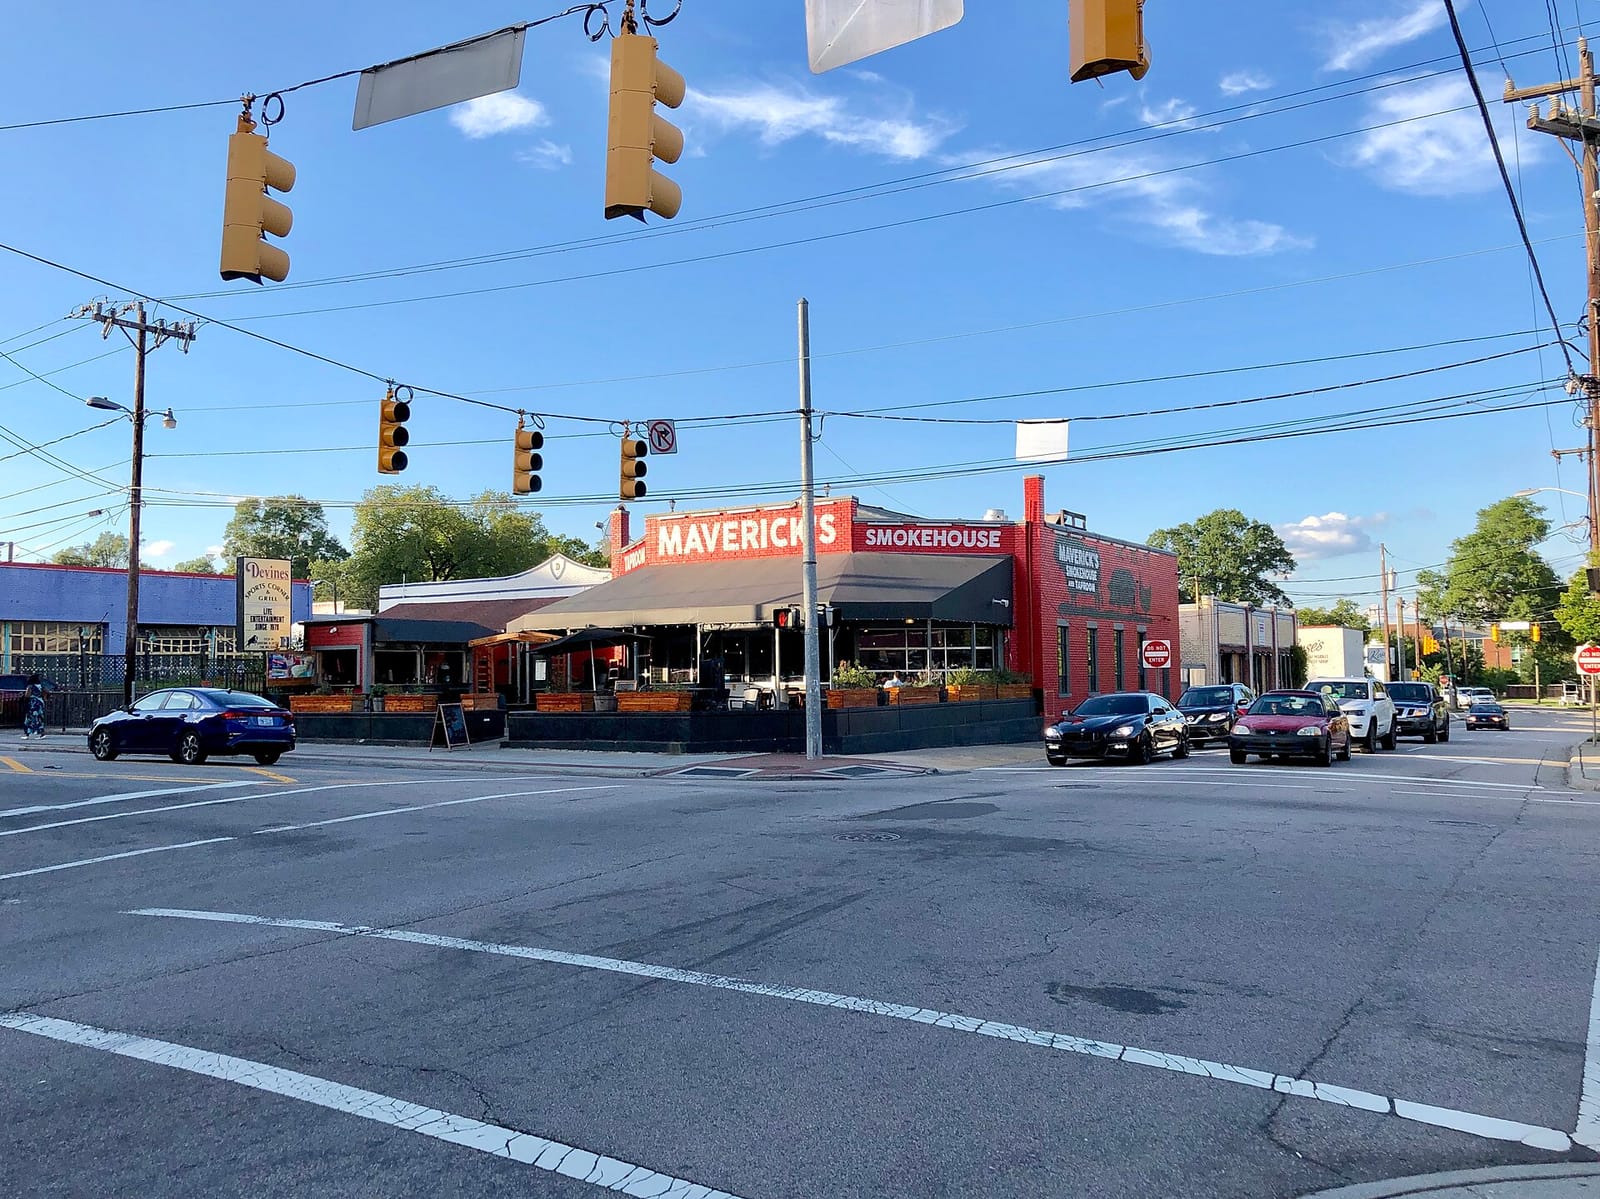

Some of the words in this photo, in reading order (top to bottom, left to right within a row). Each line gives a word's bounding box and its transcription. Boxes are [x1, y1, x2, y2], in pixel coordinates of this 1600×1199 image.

[865, 528, 1001, 548] SMOKEHOUSE
[1058, 543, 1100, 569] MAVERICK'S
[245, 561, 289, 580] Devines
[1065, 564, 1098, 581] SMOKEHOUSE
[245, 583, 266, 599] SPORTS
[267, 583, 290, 600] CORNER
[250, 615, 285, 623] ENTERTAINMENT
